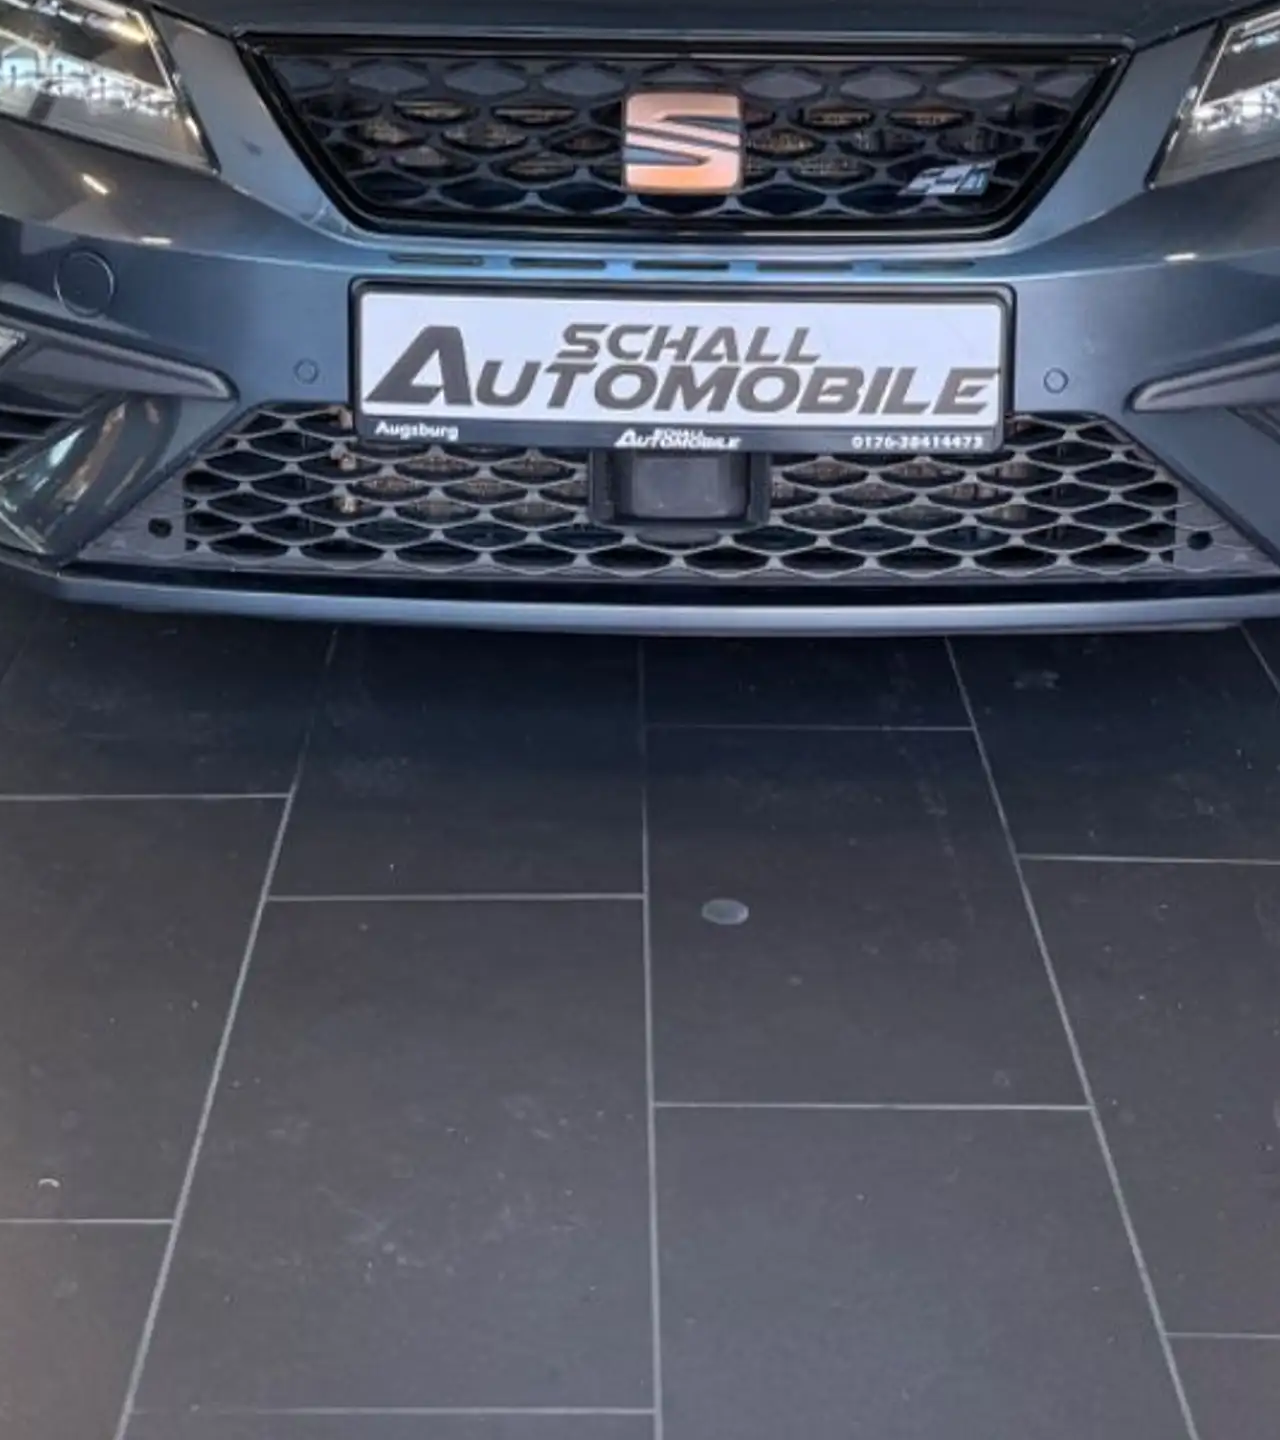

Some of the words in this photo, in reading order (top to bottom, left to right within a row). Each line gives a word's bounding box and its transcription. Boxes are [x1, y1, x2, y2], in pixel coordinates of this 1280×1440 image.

[555, 323, 821, 365] SCHALL
[365, 325, 1001, 416] AUTOMOBILE
[374, 420, 459, 441] Augsburg
